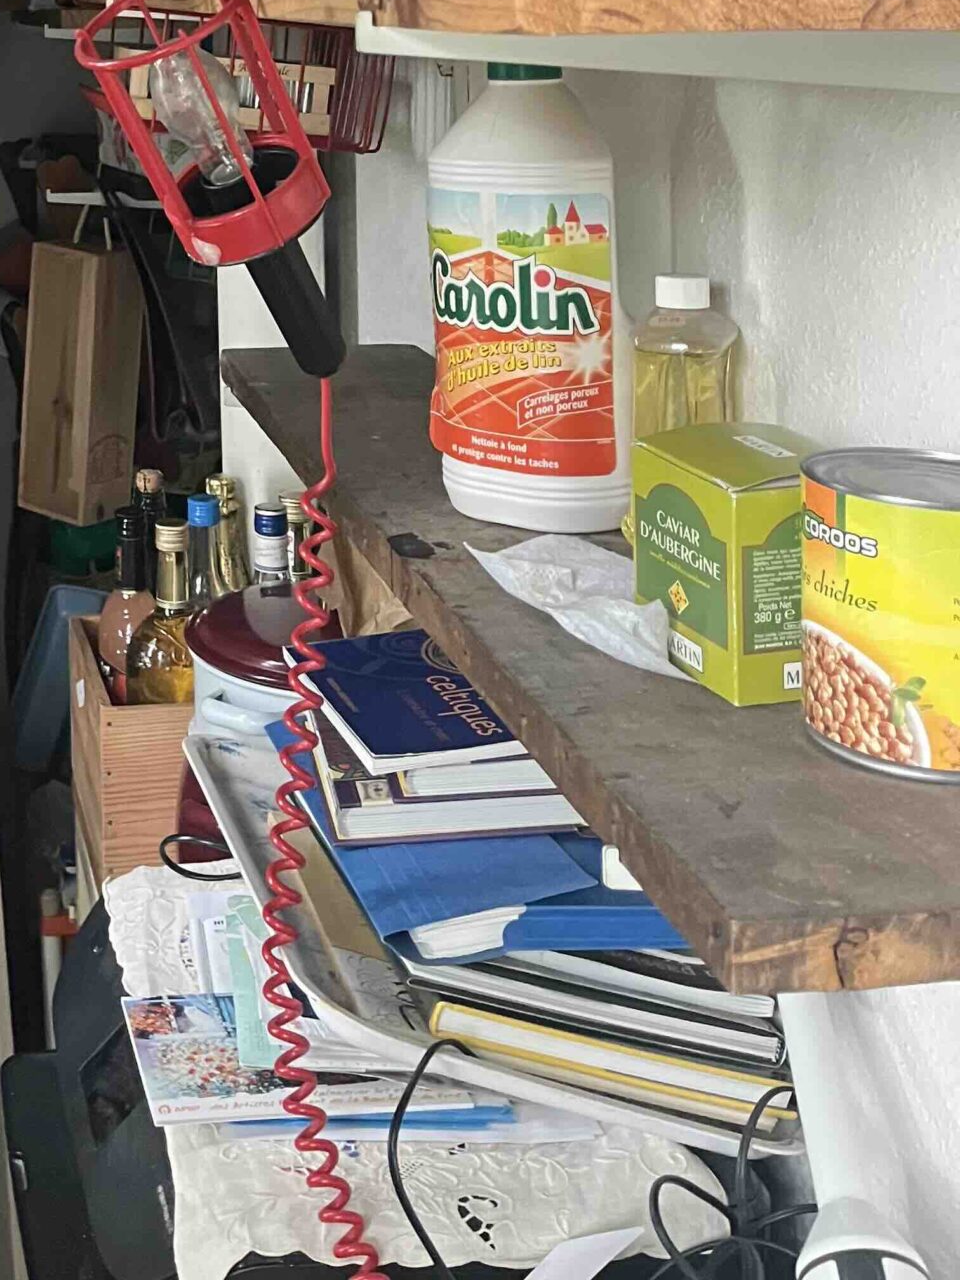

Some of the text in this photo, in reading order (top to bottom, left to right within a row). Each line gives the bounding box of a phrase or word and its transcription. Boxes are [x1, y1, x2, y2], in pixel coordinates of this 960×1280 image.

[431, 251, 596, 332] Carolin
[448, 338, 558, 367] Aux extraits
[447, 352, 562, 393] d'huile de lin
[524, 386, 600, 409] Carrelages poreux
[524, 399, 589, 419] et non poreux
[471, 435, 527, 453] Nettoie à fond
[486, 452, 513, 464] contre
[514, 456, 526, 465] les
[528, 457, 560, 469] taches
[803, 513, 878, 558] COROOS
[813, 569, 879, 613] chiches
[753, 611, 772, 624] 380
[774, 612, 782, 624] g
[758, 600, 793, 612] Poids Net
[426, 674, 503, 737] celtiques
